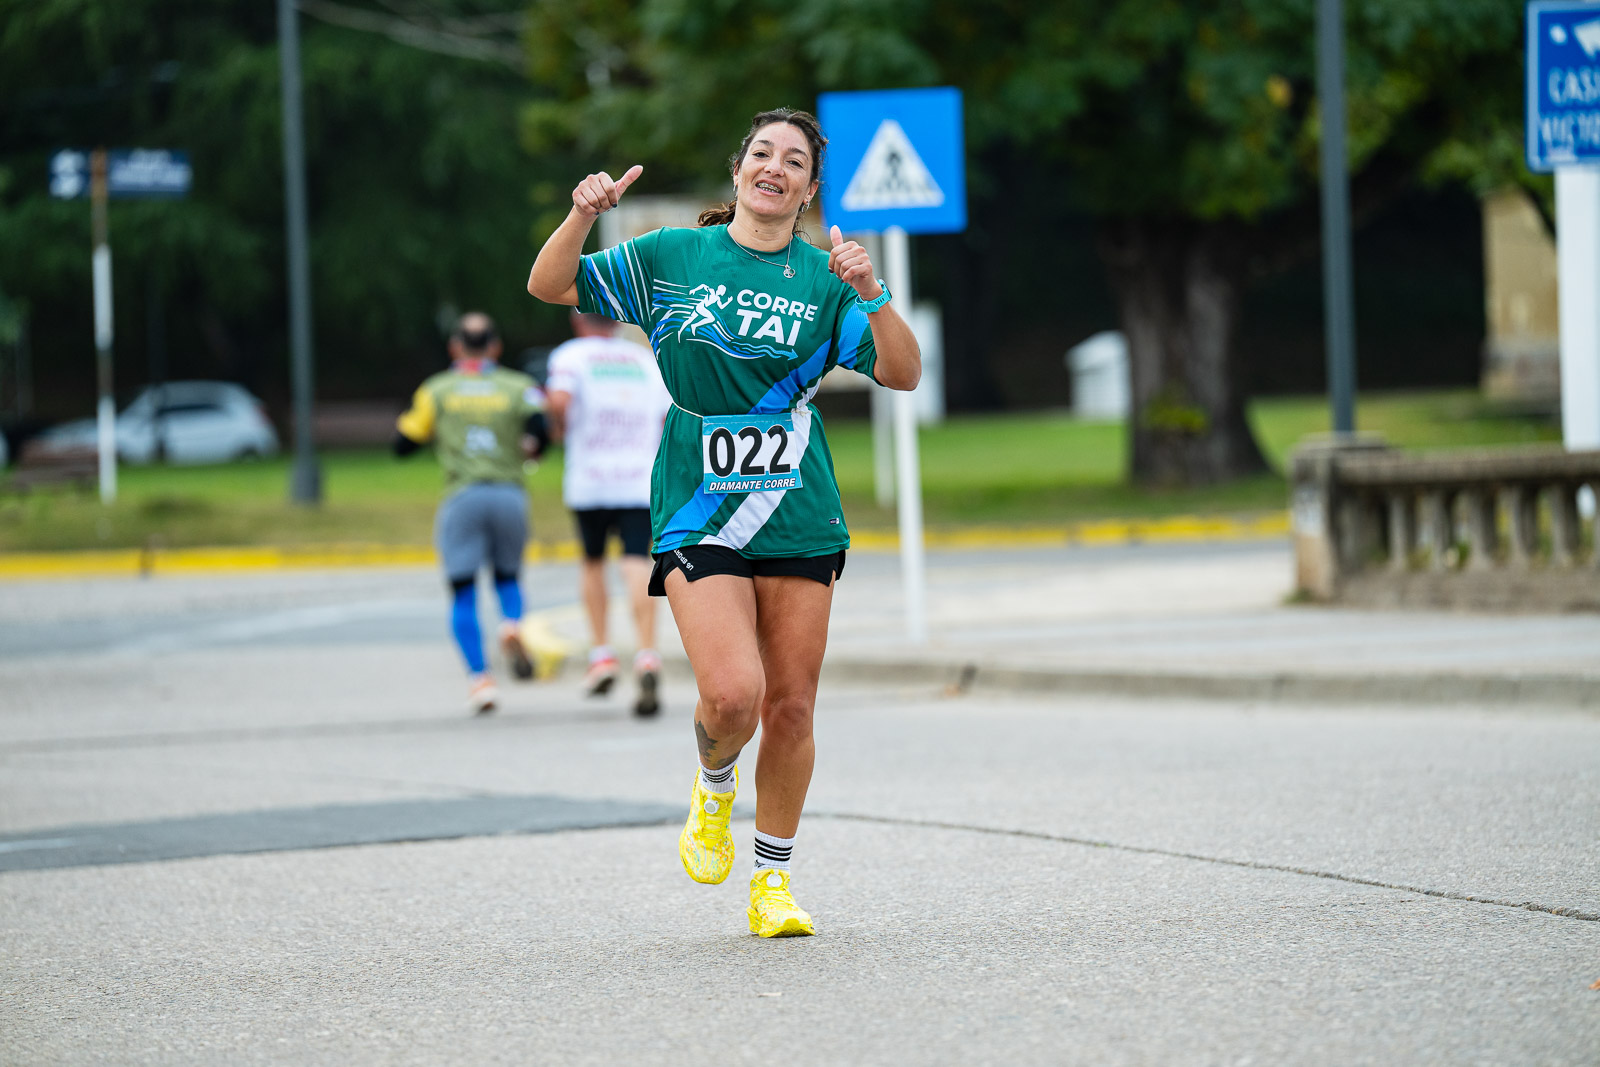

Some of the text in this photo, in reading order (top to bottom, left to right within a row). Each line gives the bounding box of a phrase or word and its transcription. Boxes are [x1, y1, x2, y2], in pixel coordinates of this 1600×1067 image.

[736, 289, 818, 322] CORRE
[736, 308, 802, 347] TAI
[709, 424, 792, 478] 022
[709, 477, 796, 491] DIAMANTE CORRE
